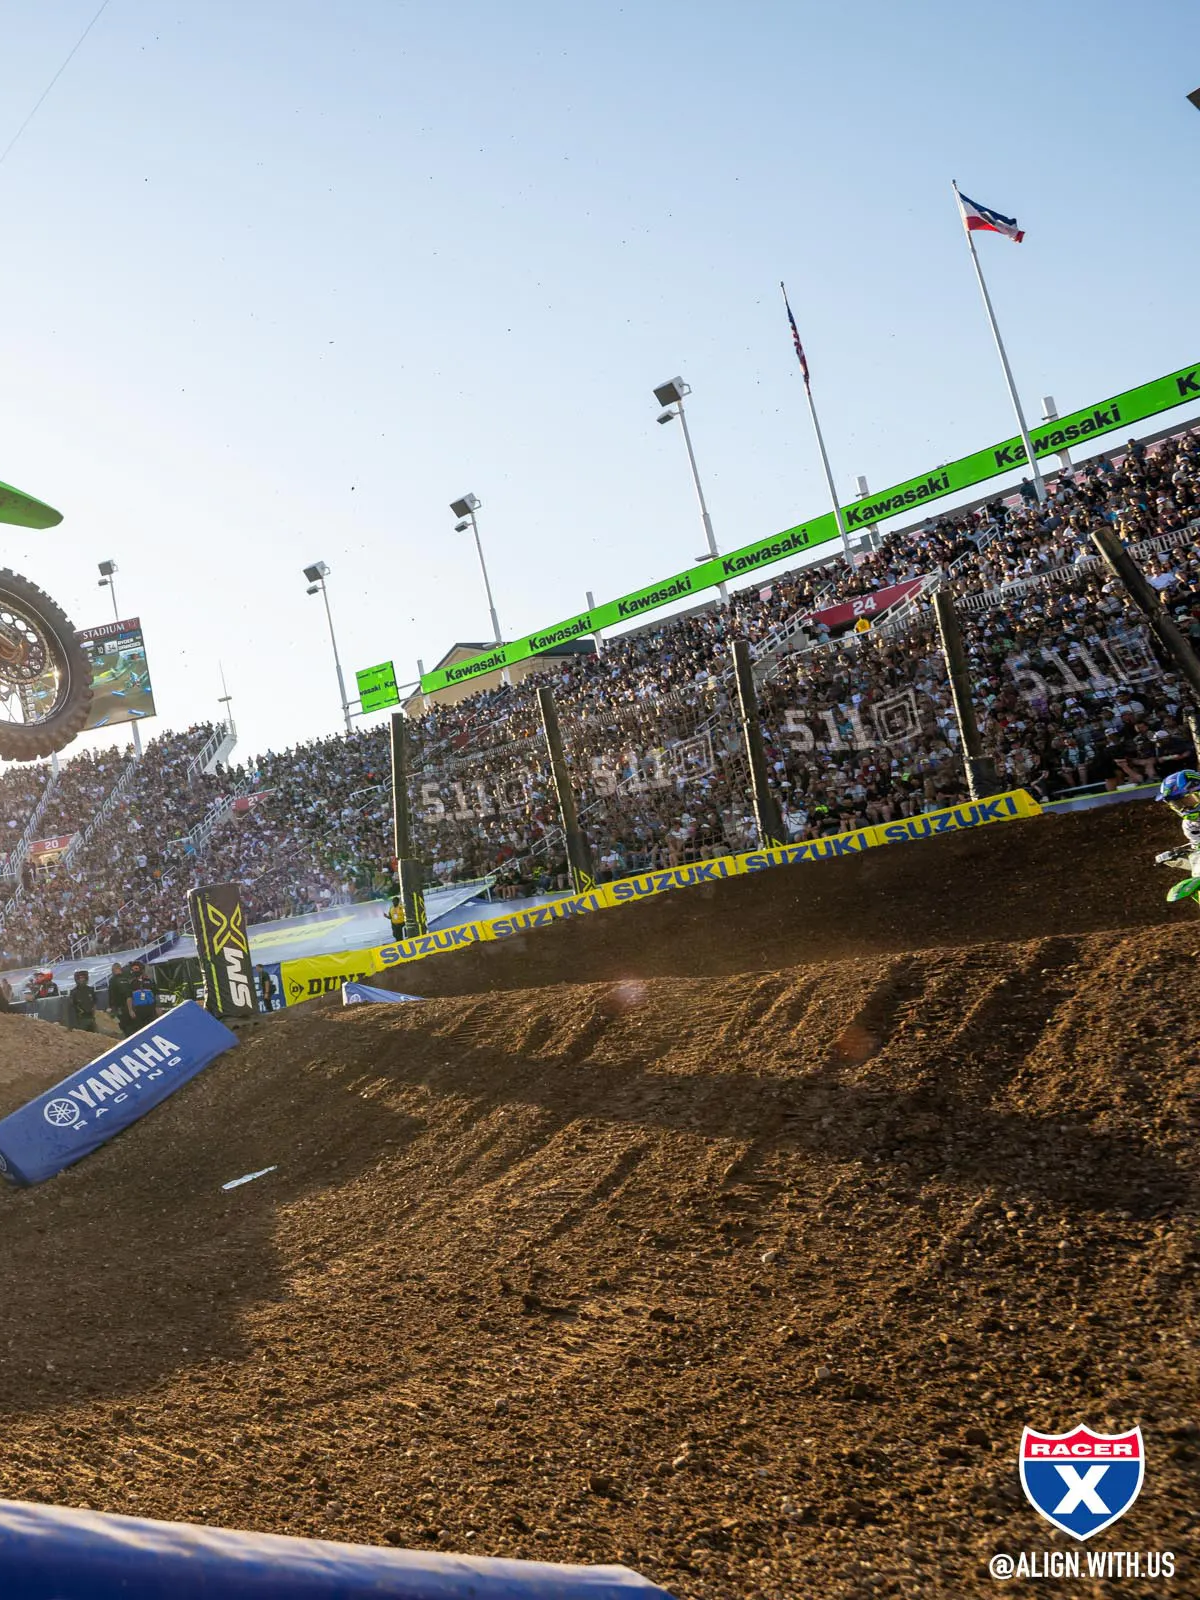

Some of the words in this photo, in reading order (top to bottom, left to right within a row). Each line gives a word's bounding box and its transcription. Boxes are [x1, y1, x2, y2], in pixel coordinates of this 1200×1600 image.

[994, 403, 1121, 468] Kawasaki
[846, 472, 951, 526] Kawasaki
[722, 528, 810, 575] Kawasaki
[618, 576, 692, 617] Kawasaki
[852, 596, 876, 617] 24
[82, 623, 125, 640] STADIUM
[528, 616, 593, 653] Kawasaki
[445, 651, 507, 682] Kawasaki
[883, 796, 1019, 845] SUZUKI
[44, 839, 59, 850] 20
[745, 832, 869, 874] SUZUKI
[612, 860, 729, 901] SUZUKI
[491, 895, 600, 938] SUZUKI
[379, 924, 480, 965] SUZUKI
[68, 1034, 181, 1108] YAMAHA
[72, 1056, 183, 1131] RACING
